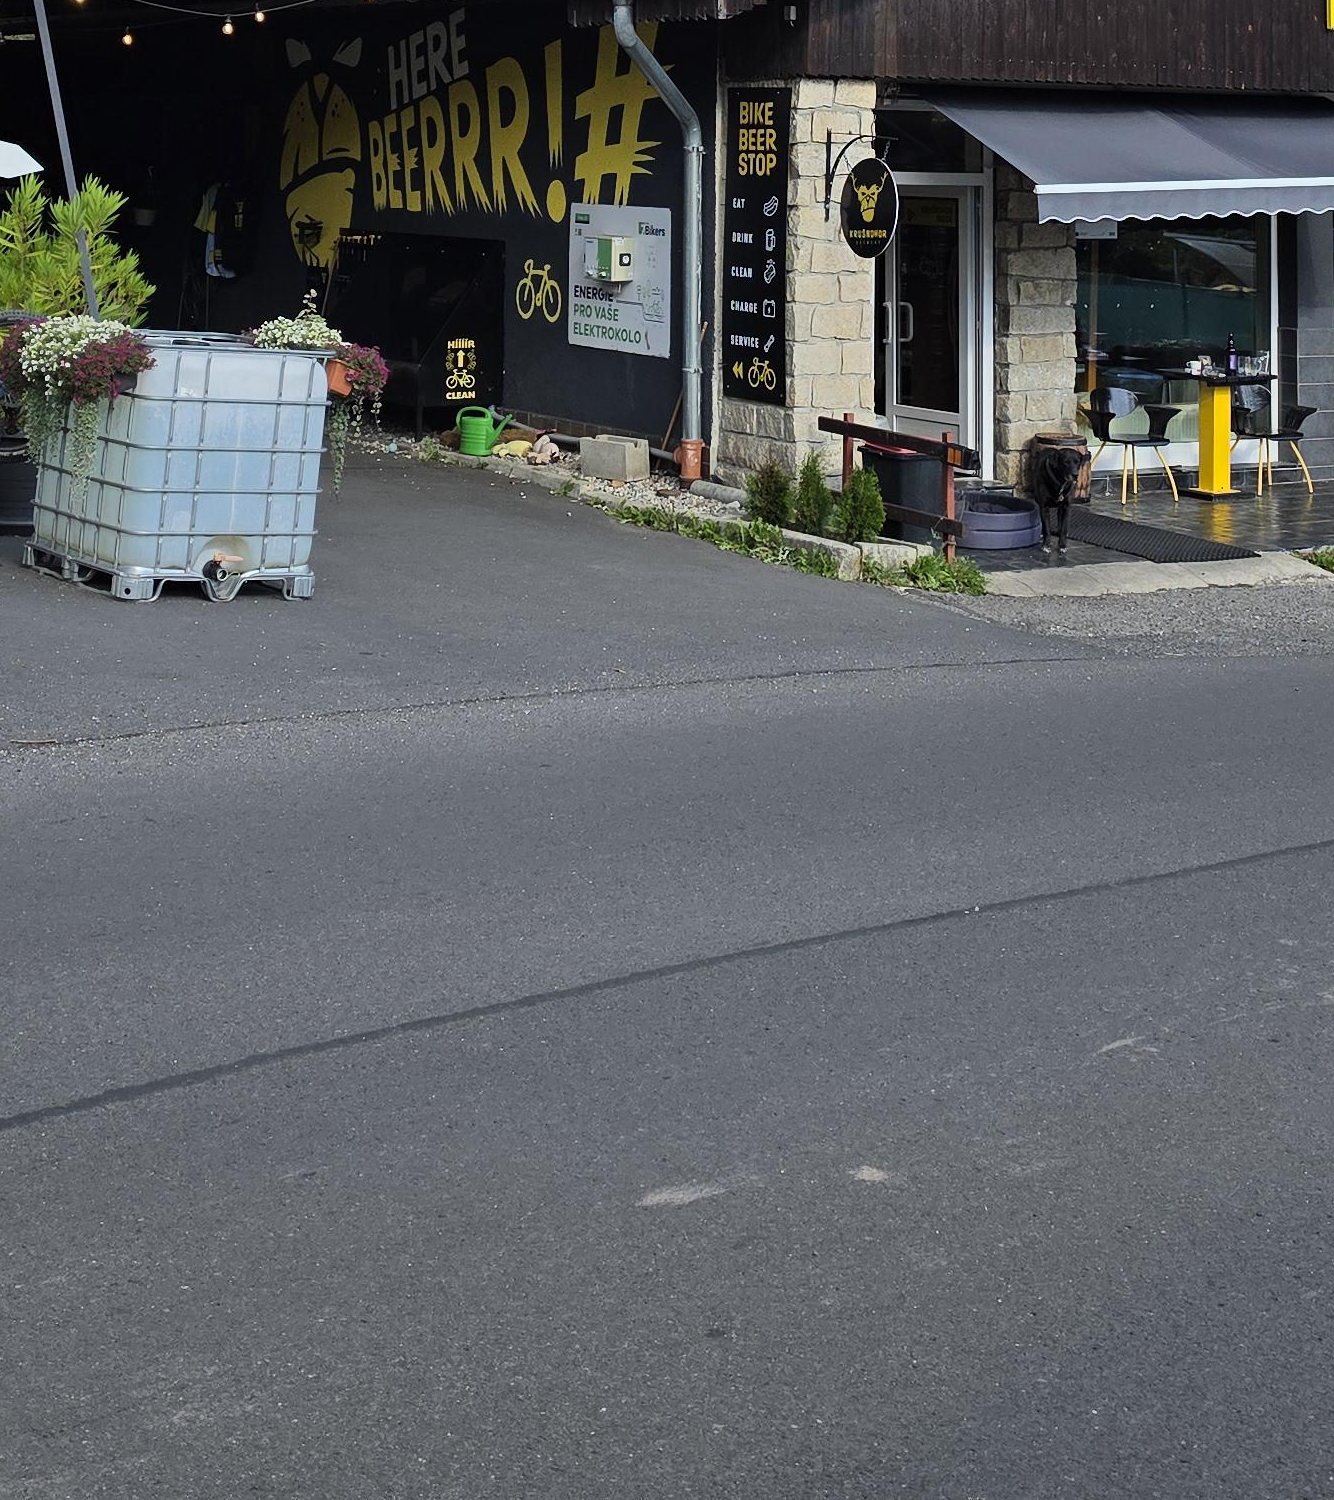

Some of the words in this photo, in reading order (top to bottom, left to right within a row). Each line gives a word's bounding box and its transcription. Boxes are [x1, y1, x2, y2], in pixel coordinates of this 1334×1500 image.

[387, 7, 469, 110] HERE
[739, 101, 774, 125] BIKE
[738, 128, 777, 151] BEER
[738, 152, 777, 176] STOP
[732, 198, 746, 209] EAT
[732, 231, 754, 244] DRINK
[731, 266, 753, 278] CLEAN
[573, 284, 614, 303] ENERGIE
[573, 303, 592, 319] PRO
[595, 303, 619, 322] VAŠE
[730, 299, 758, 314] CHARGE
[573, 322, 642, 344] ELEKTROKOLO
[730, 334, 760, 349] SERVICE
[445, 390, 476, 400] CLEAN
